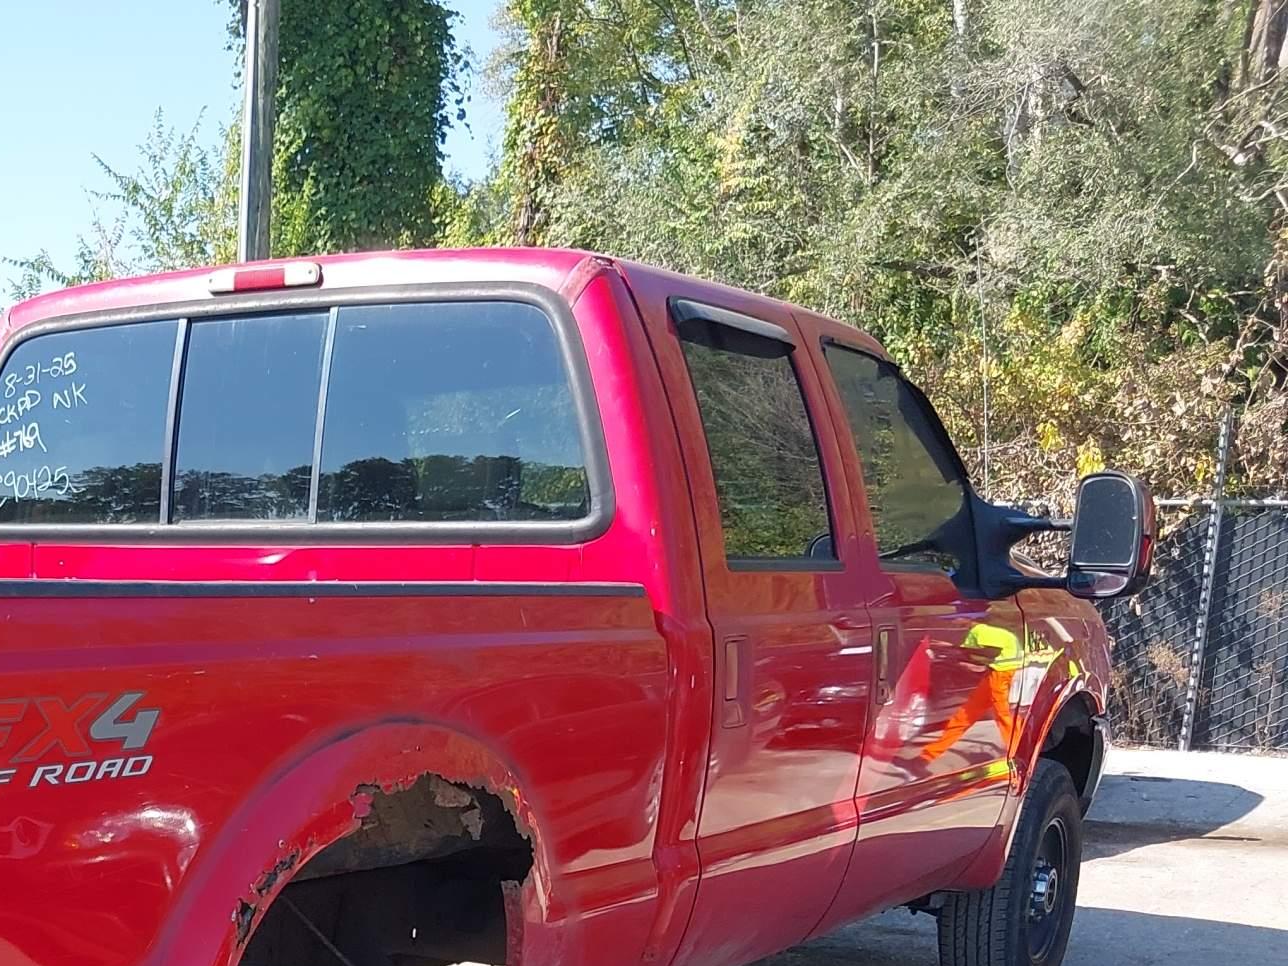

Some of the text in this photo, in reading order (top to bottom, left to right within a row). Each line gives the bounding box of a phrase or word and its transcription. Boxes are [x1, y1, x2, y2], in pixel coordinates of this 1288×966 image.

[4, 351, 77, 398] 8-31-25
[52, 382, 88, 409] NK
[28, 754, 154, 788] ROAD
